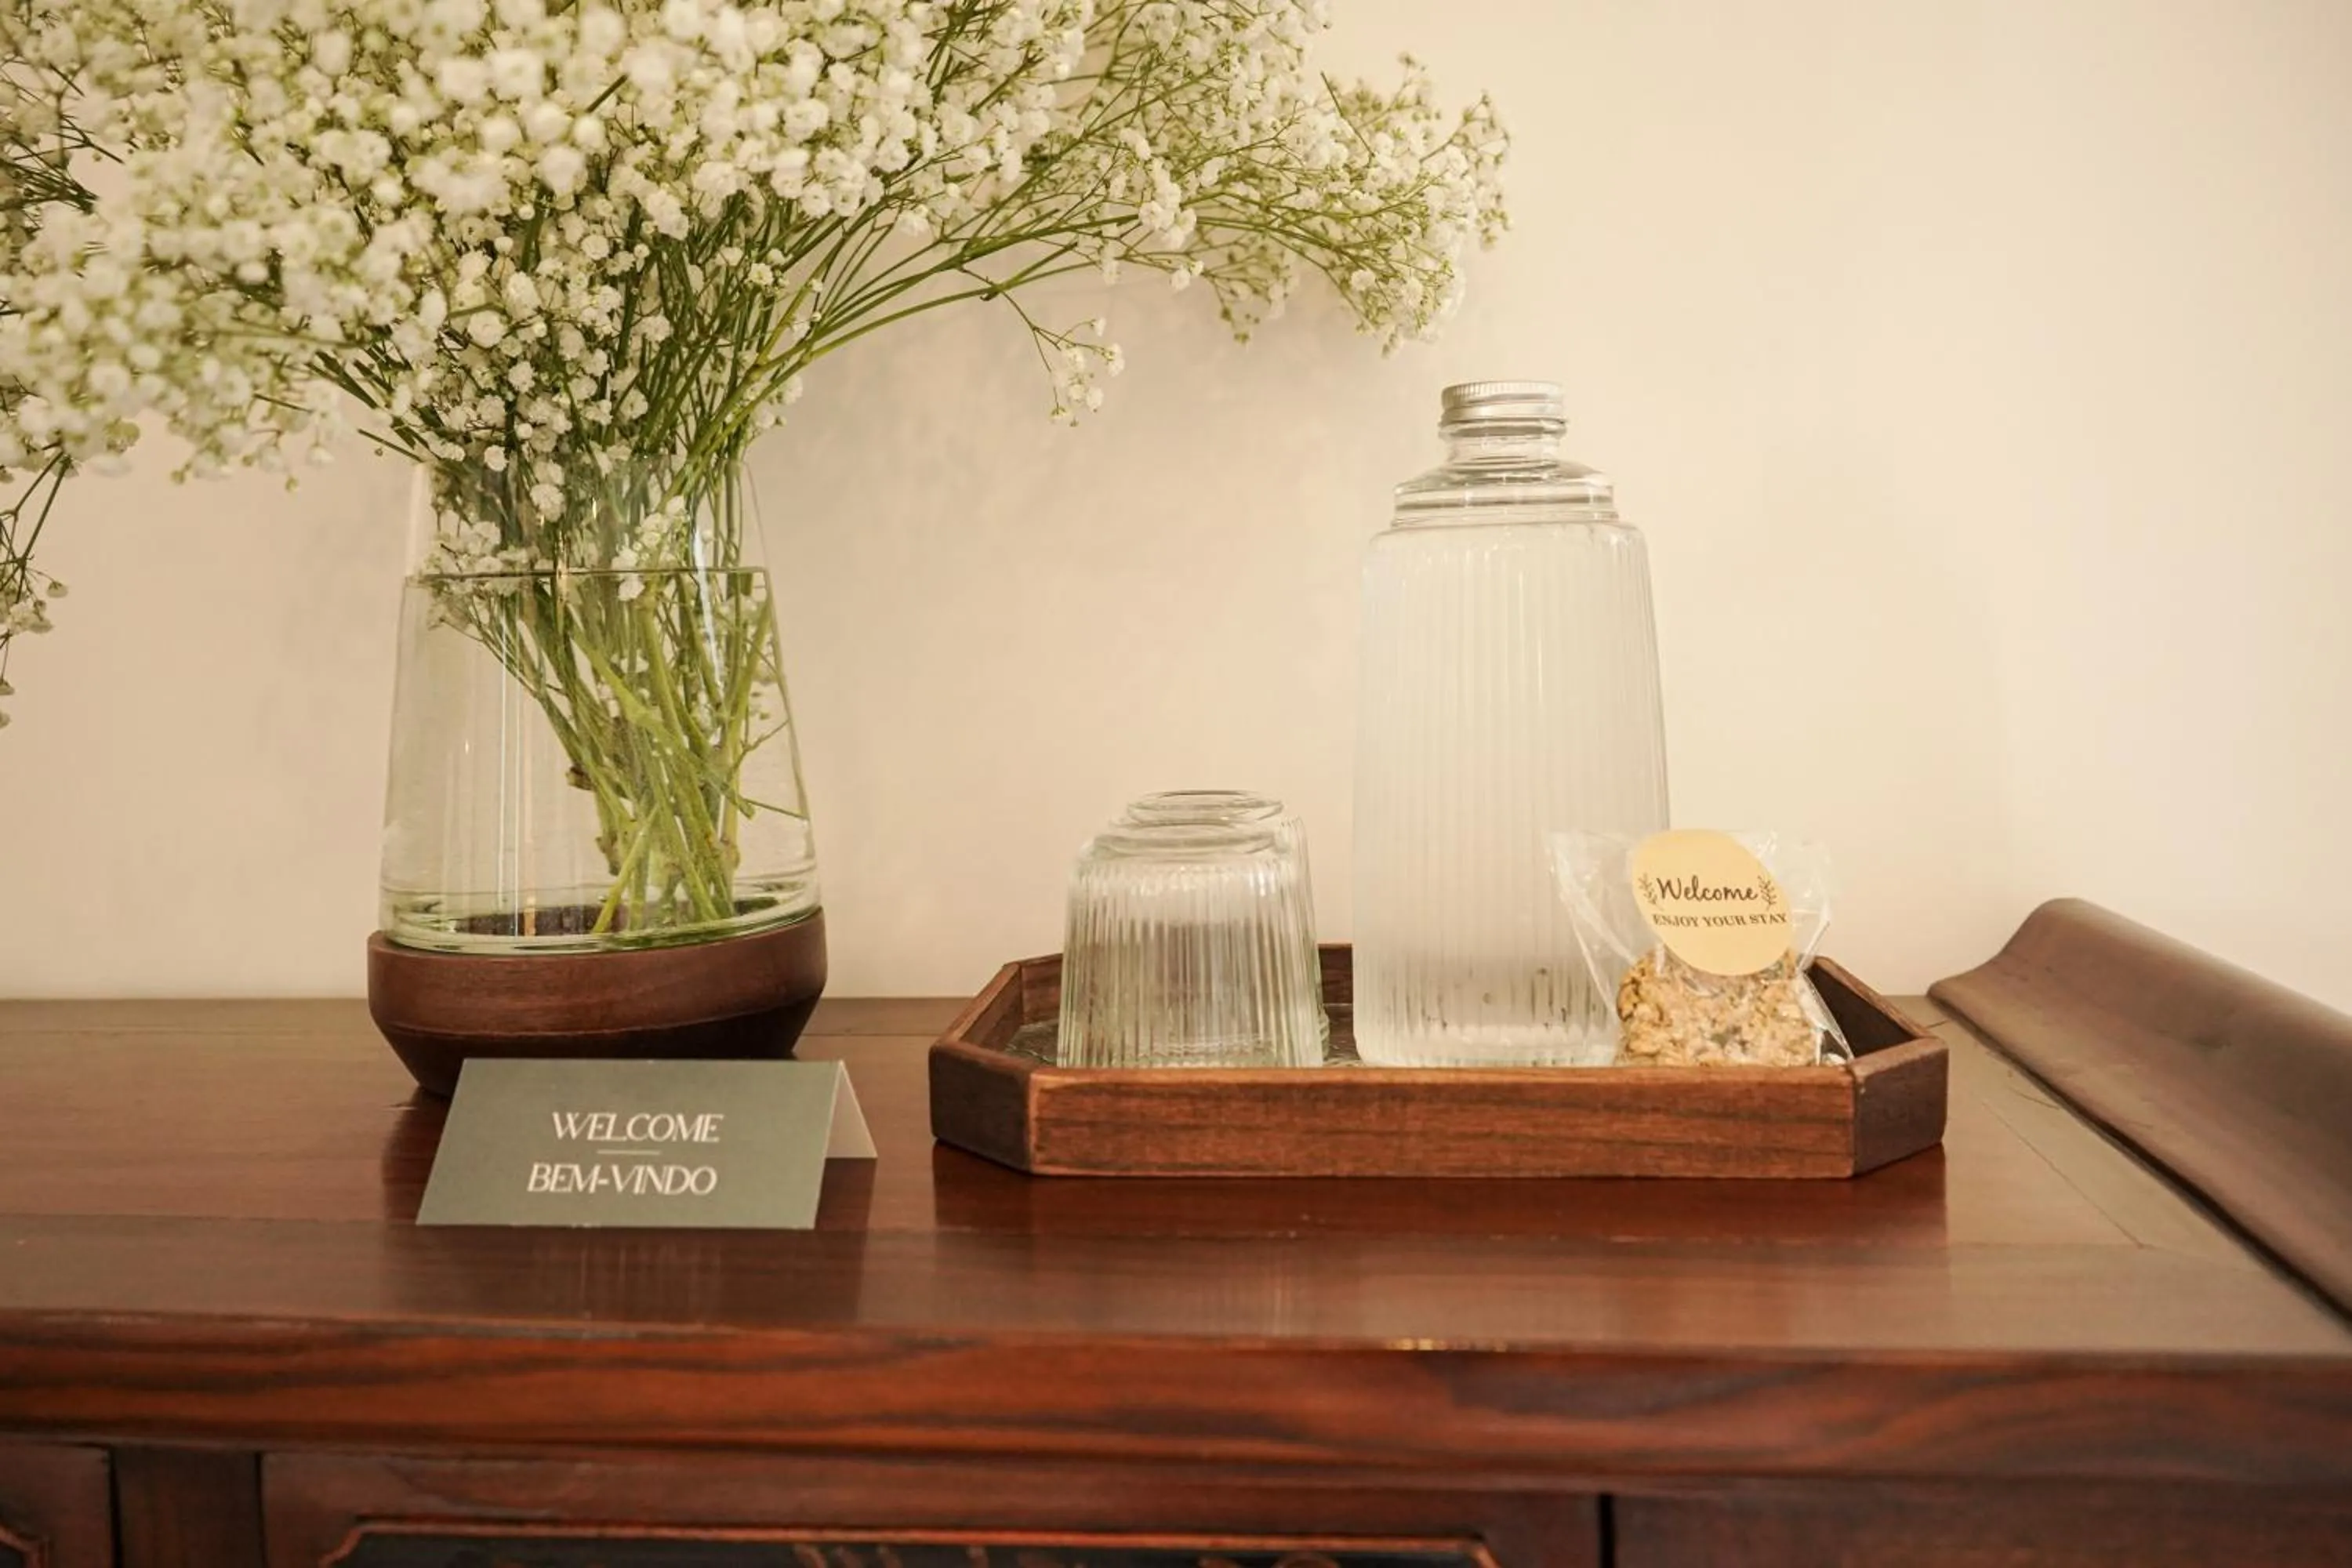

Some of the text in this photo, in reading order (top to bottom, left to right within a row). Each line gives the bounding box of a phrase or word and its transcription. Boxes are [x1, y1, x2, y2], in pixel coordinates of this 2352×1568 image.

[1656, 874, 1758, 902] Welcome
[1652, 913, 1788, 927] ENJOY YOUR STAY
[552, 1112, 724, 1142] WELCOME
[526, 1163, 717, 1196] BEM-VINDO
